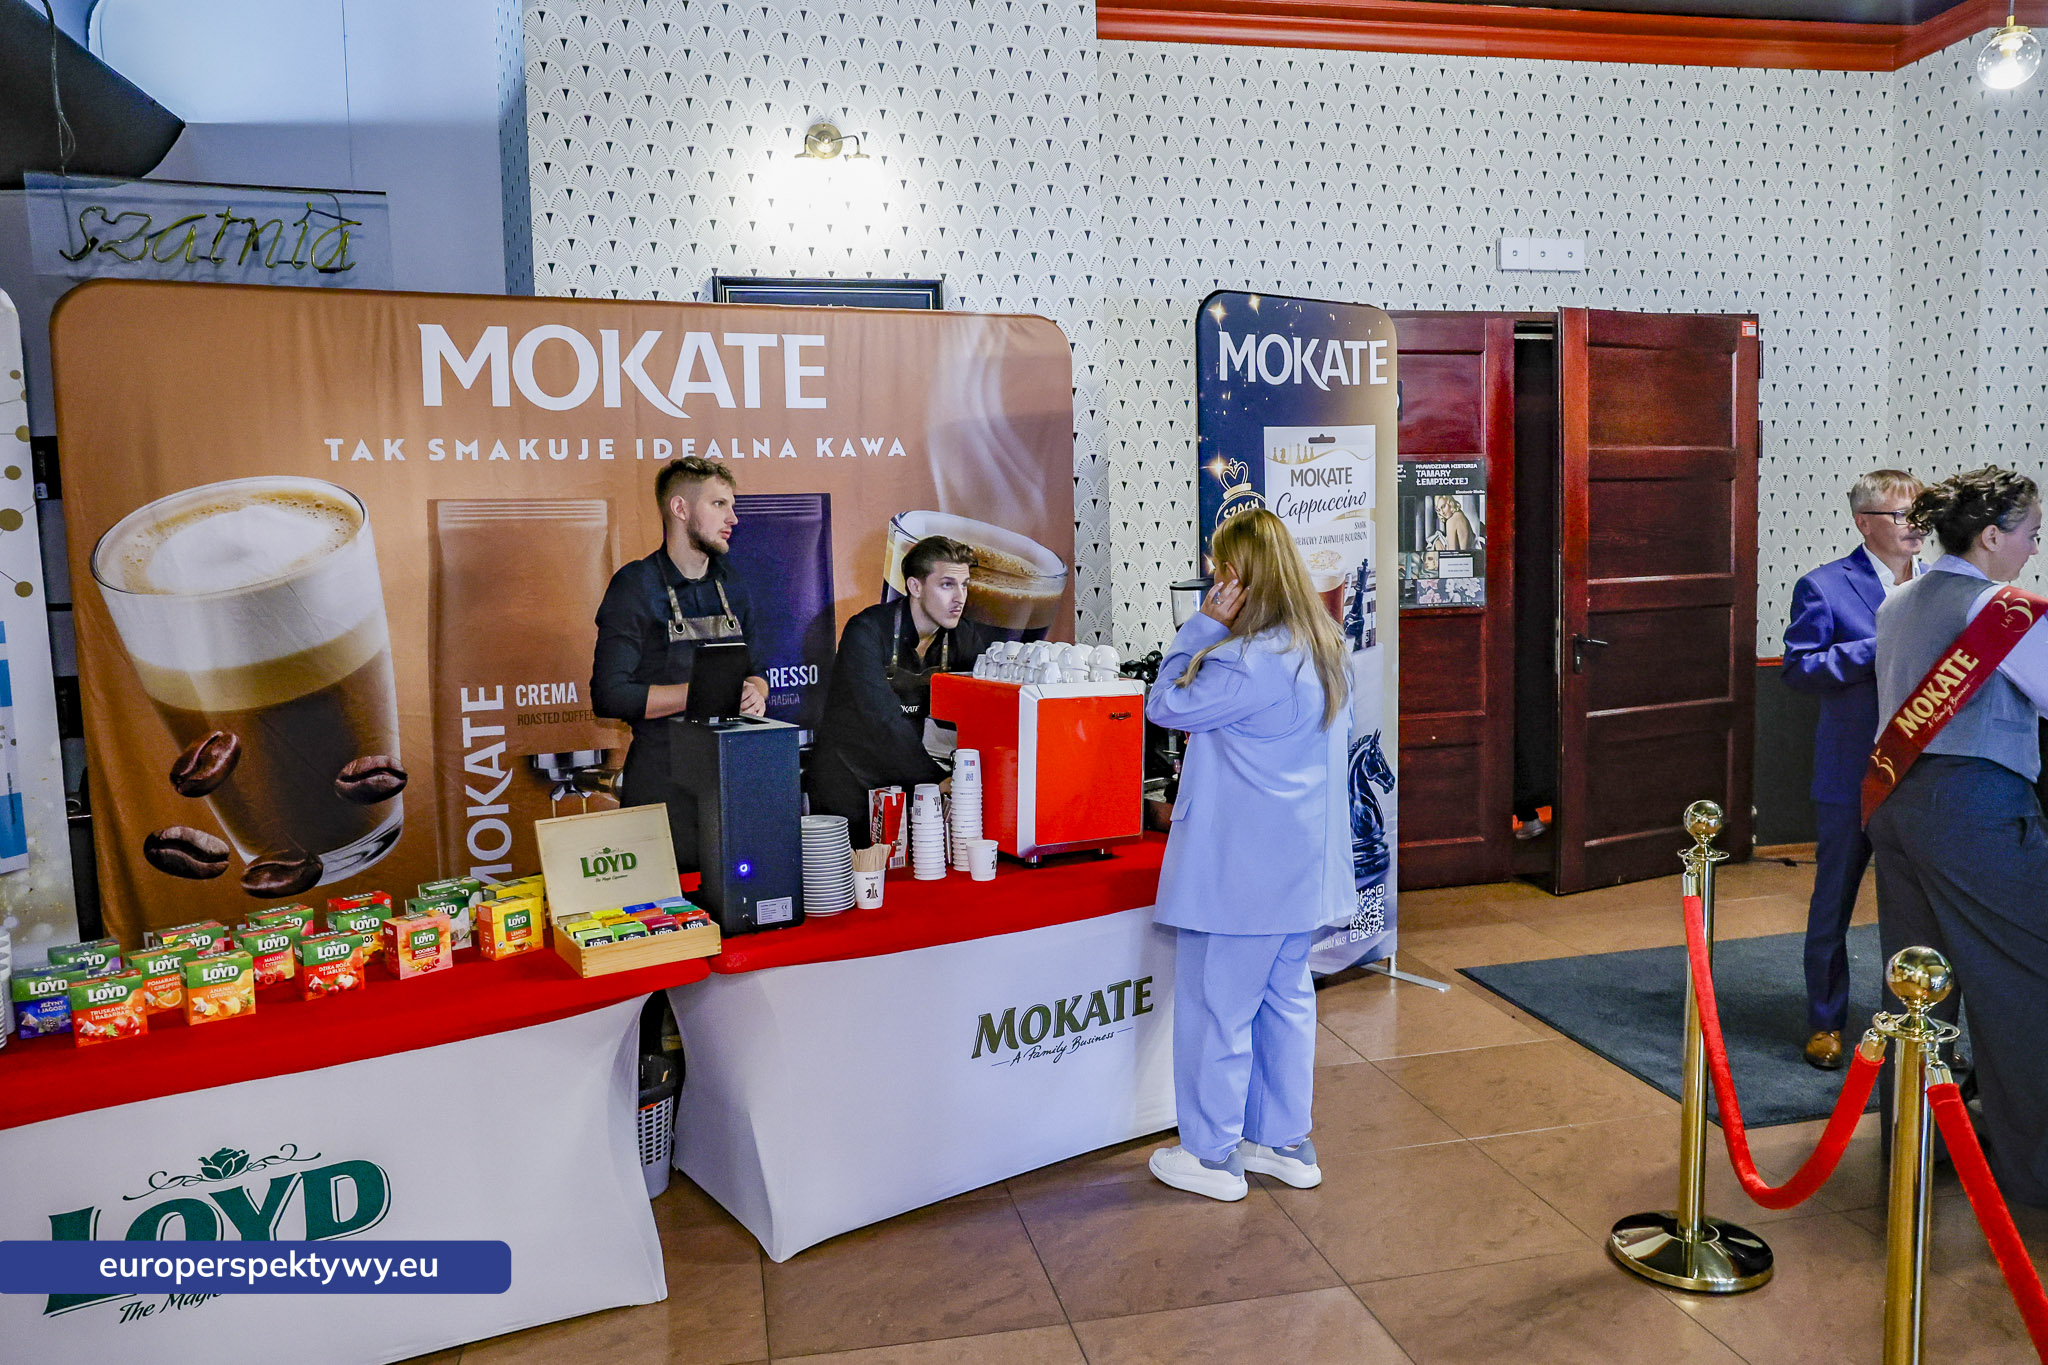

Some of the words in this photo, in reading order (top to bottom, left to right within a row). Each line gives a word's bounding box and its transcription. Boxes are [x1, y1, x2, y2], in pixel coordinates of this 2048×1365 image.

[417, 324, 827, 418] MOKATE
[1218, 331, 1388, 391] MOKATE
[325, 438, 405, 462] TAK
[429, 438, 615, 461] SMAKUJE
[636, 437, 798, 460] IDEALNA
[816, 436, 907, 458] KAWA
[1291, 467, 1352, 488] MOKATE
[1416, 478, 1468, 486] ŁEMPICKIEJ
[1276, 489, 1366, 525] Cappuccino
[766, 664, 818, 688] RESSO
[515, 682, 578, 706] CREMA
[1895, 648, 1980, 739] MOKATE
[517, 712, 560, 726] ROASTED
[580, 853, 637, 878] LOYD
[428, 904, 458, 915] OYD
[350, 918, 379, 931] LOYD
[508, 916, 527, 927] LOYD
[258, 936, 289, 951] LOYD
[414, 934, 435, 944] LOYD
[317, 944, 350, 959] LOYD
[203, 966, 238, 981] LOYD
[29, 980, 68, 995] LOYD
[88, 985, 128, 1003] LOYD
[971, 976, 1154, 1059] MOKATE
[1010, 1051, 1021, 1066] A
[1023, 1041, 1067, 1064] Family
[1067, 1031, 1115, 1054] Business
[119, 1301, 155, 1324] The
[159, 1293, 222, 1313] Mag
